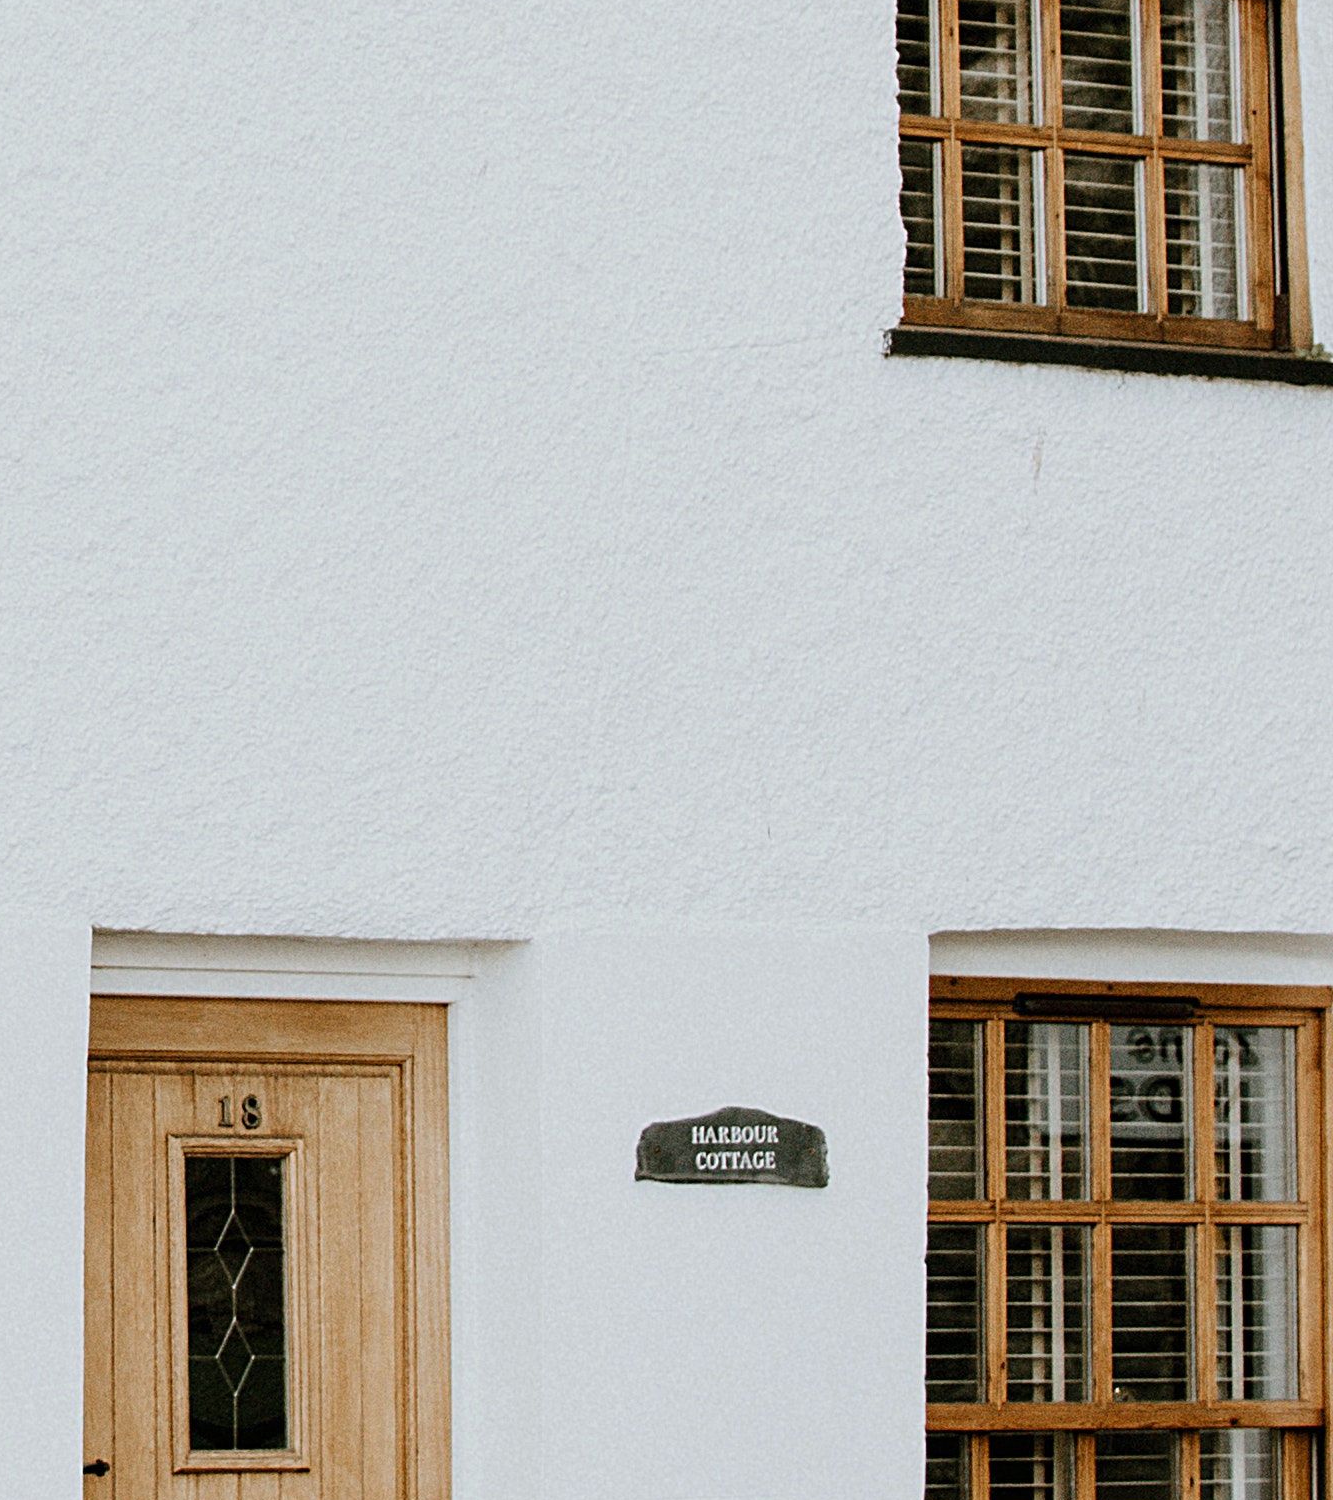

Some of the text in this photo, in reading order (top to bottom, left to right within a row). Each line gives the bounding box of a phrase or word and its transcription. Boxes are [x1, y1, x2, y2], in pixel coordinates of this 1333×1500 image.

[218, 1094, 262, 1129] 18
[691, 1125, 779, 1145] HARBOUR
[695, 1151, 776, 1170] COTTAGE
